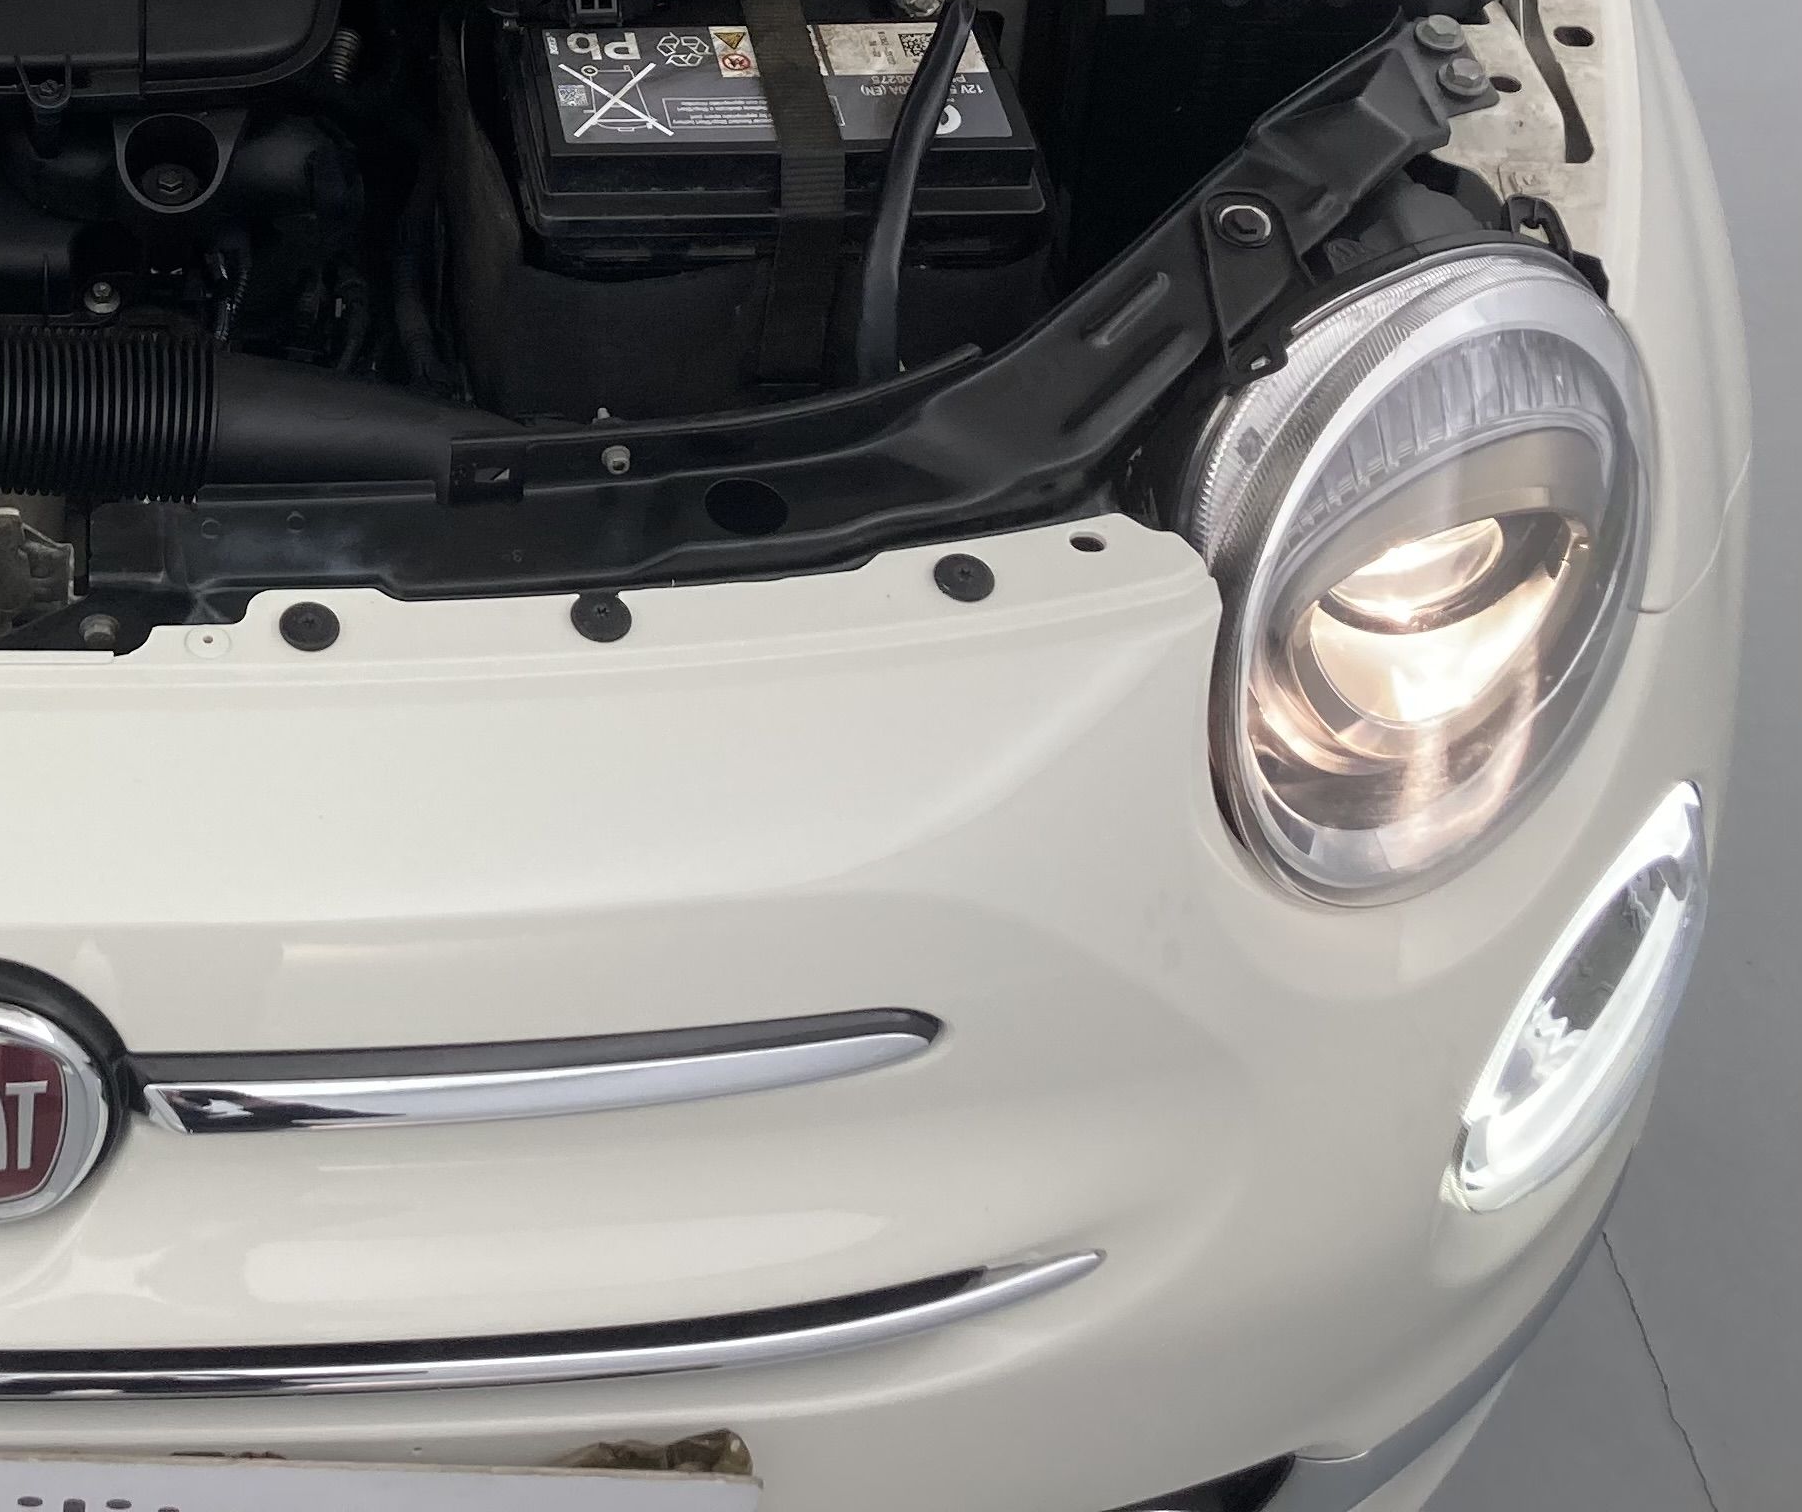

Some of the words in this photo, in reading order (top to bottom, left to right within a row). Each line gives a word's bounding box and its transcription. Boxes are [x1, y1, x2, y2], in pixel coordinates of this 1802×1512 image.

[566, 31, 642, 61] Pb
[861, 85, 887, 96] (EN)
[960, 84, 984, 94] 12V
